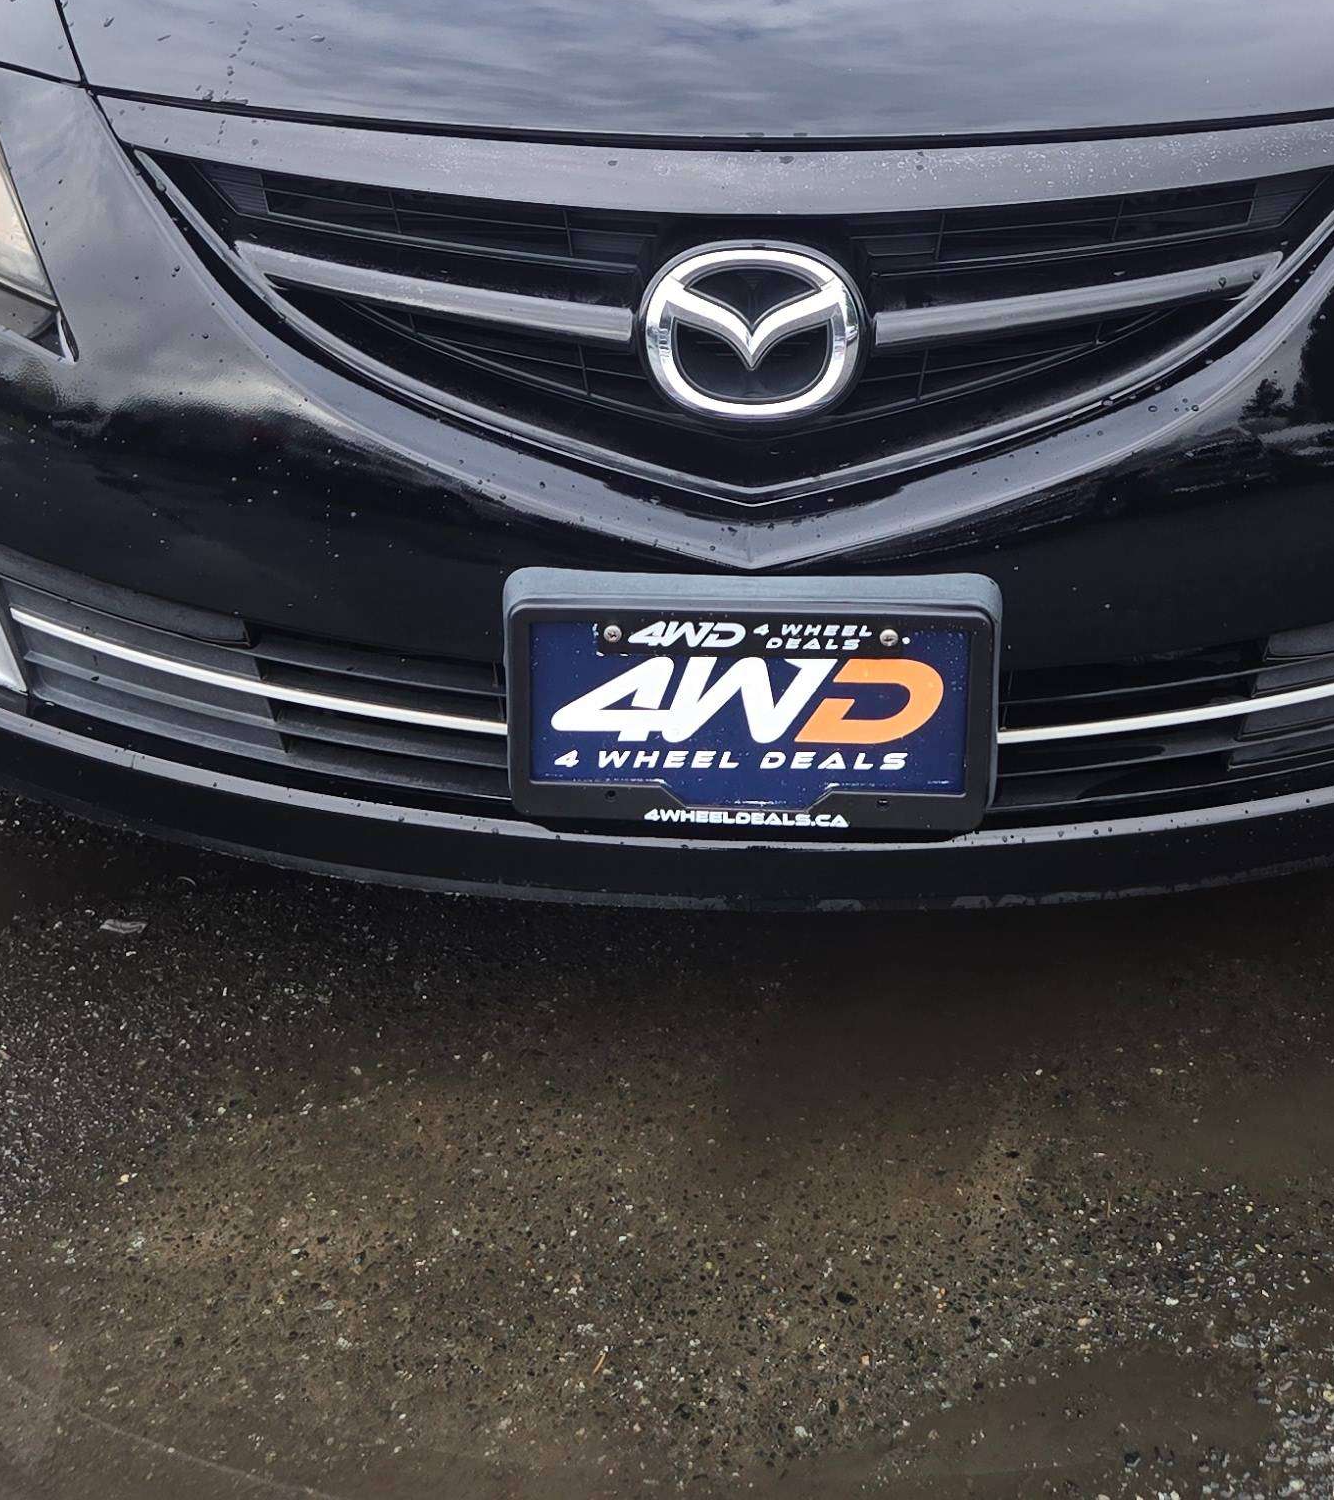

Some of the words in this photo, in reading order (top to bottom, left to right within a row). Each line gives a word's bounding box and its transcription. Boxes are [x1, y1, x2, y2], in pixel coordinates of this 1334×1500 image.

[628, 621, 746, 648] 4WD
[781, 623, 872, 637] WHEEL
[765, 637, 861, 650] DEALS
[550, 656, 944, 744] 4WD
[554, 749, 579, 767] 4
[598, 751, 738, 769] WHEEL
[759, 751, 908, 770] DEALS
[644, 808, 850, 828] 4WHEELDEALS.CA
